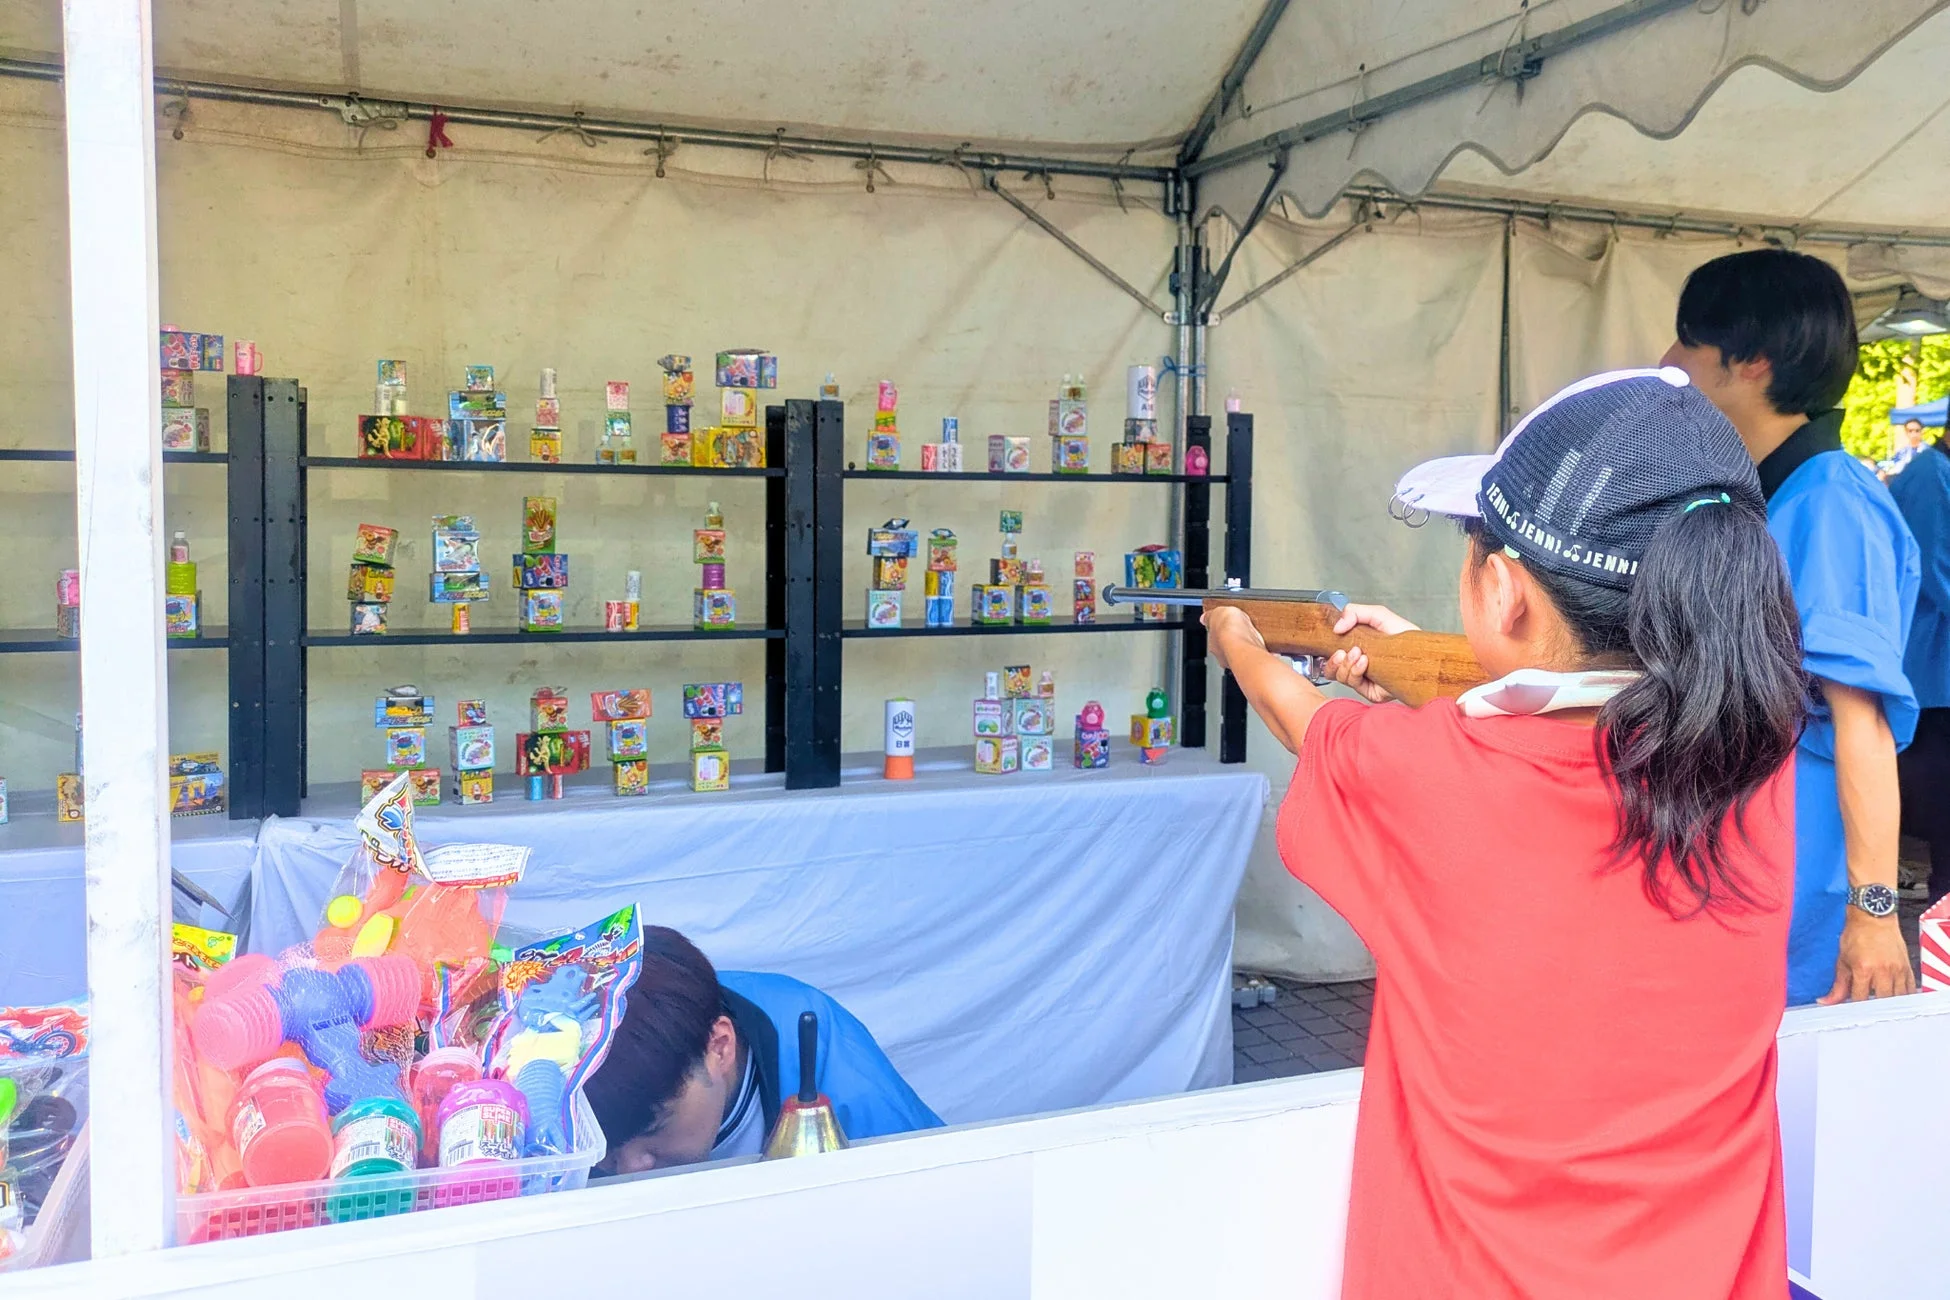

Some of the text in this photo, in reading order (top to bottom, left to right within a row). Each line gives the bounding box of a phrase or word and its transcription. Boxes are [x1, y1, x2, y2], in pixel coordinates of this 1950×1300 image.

[1486, 482, 1509, 524] JENNI
[1518, 519, 1561, 554] JENNI
[1582, 550, 1637, 576] JENNI
